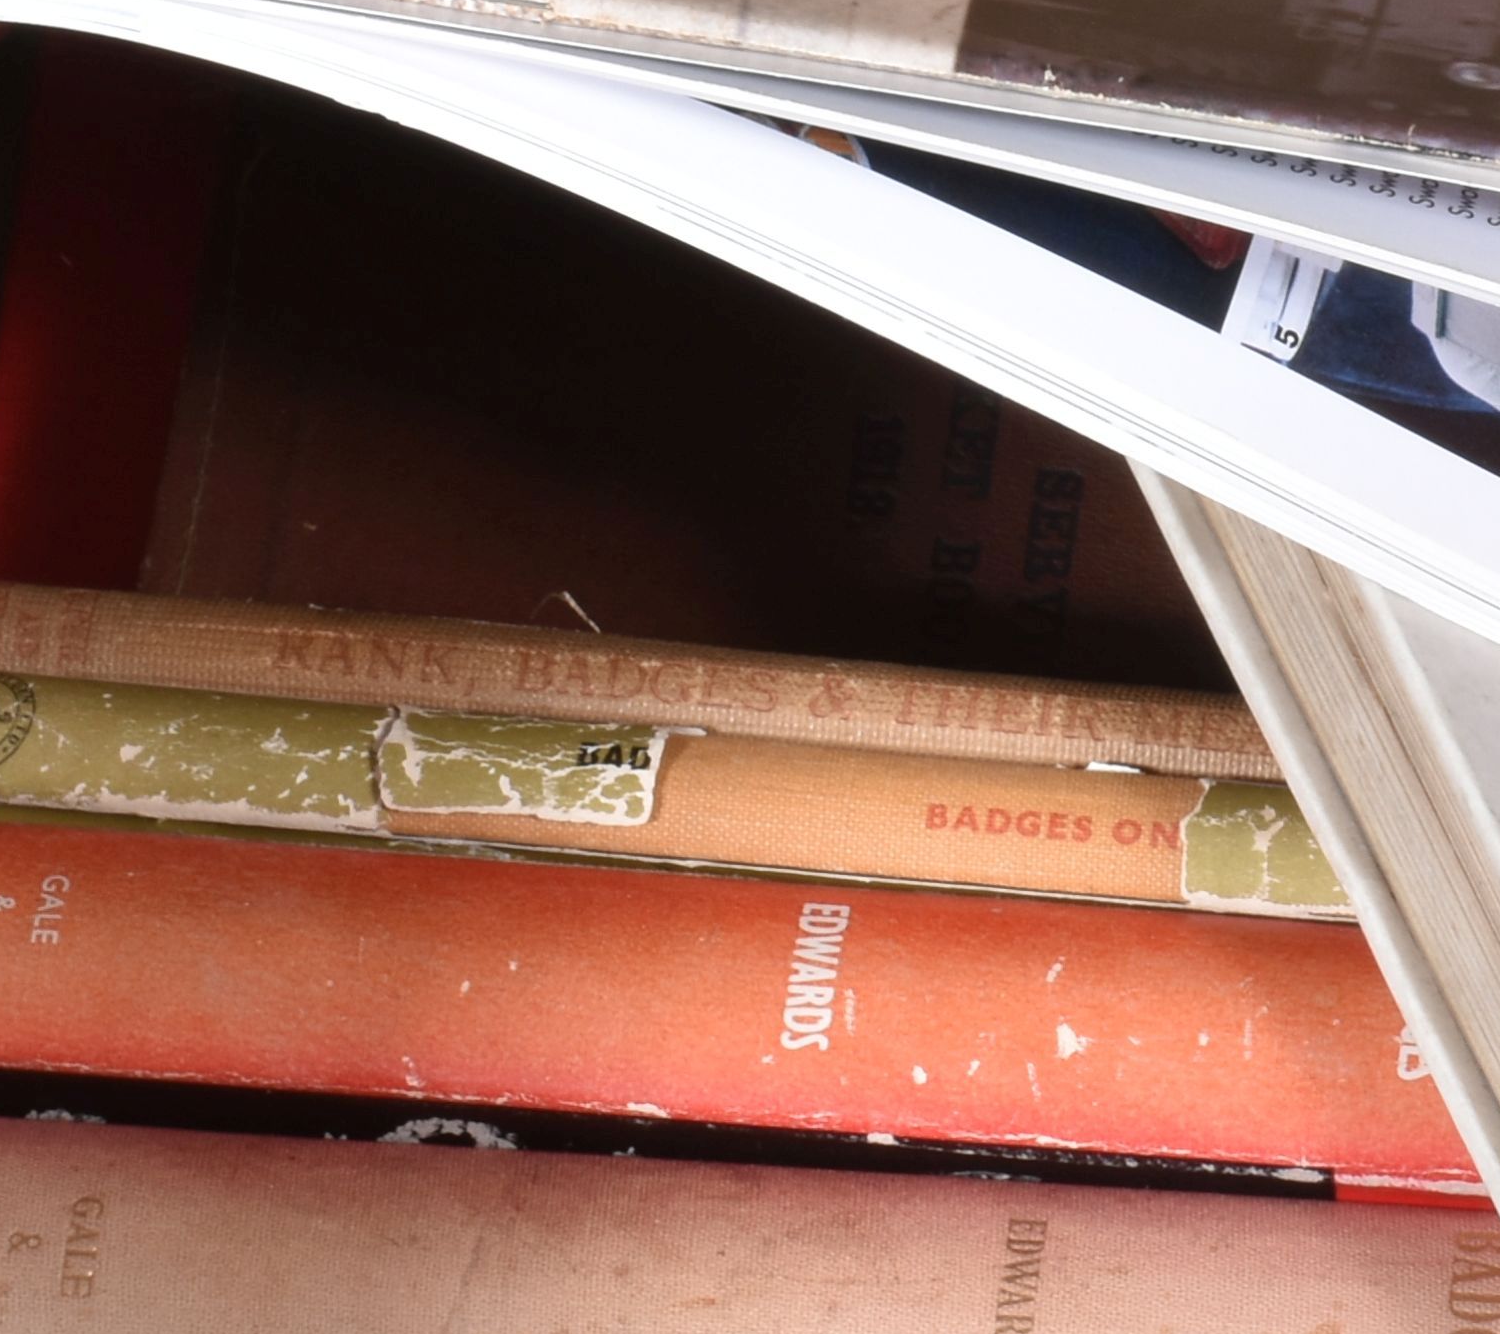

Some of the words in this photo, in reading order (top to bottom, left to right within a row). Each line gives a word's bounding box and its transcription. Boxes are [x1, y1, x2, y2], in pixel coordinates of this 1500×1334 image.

[1273, 324, 1300, 350] 5
[275, 633, 476, 696] RANK,
[517, 648, 778, 713] BADGES
[809, 673, 852, 721] &
[896, 681, 1101, 741] THEIR
[924, 803, 1094, 843] BADGES
[1111, 817, 1181, 849] ON
[30, 874, 71, 947] GALE
[780, 901, 850, 1053] EDWARDS
[6, 1232, 43, 1259] &
[59, 1195, 105, 1300] GALE
